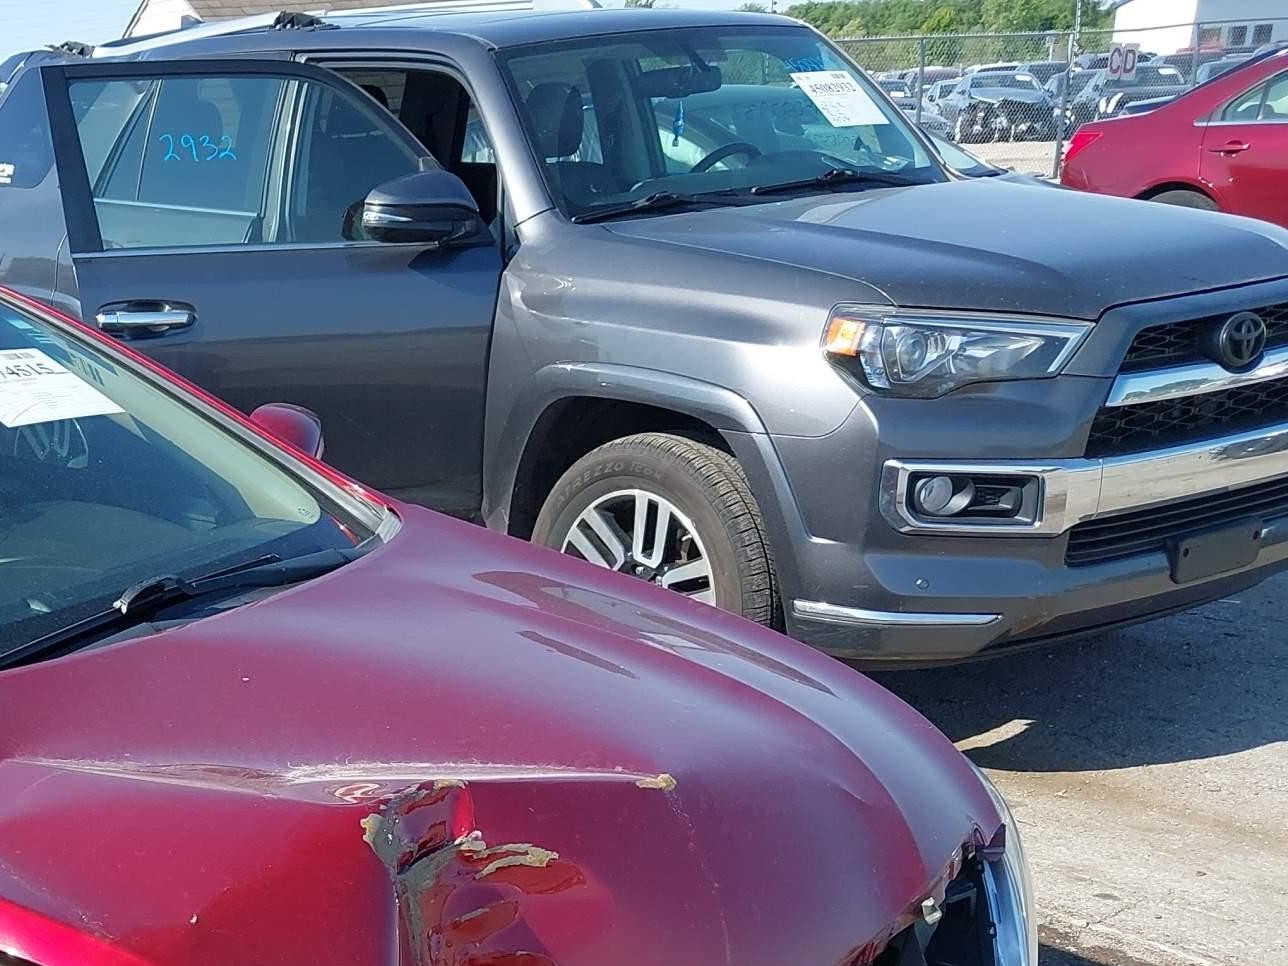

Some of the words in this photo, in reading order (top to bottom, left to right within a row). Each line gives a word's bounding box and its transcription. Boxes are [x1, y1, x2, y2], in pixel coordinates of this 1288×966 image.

[1109, 47, 1122, 74] C
[1123, 49, 1137, 74] D
[158, 134, 238, 162] 2932
